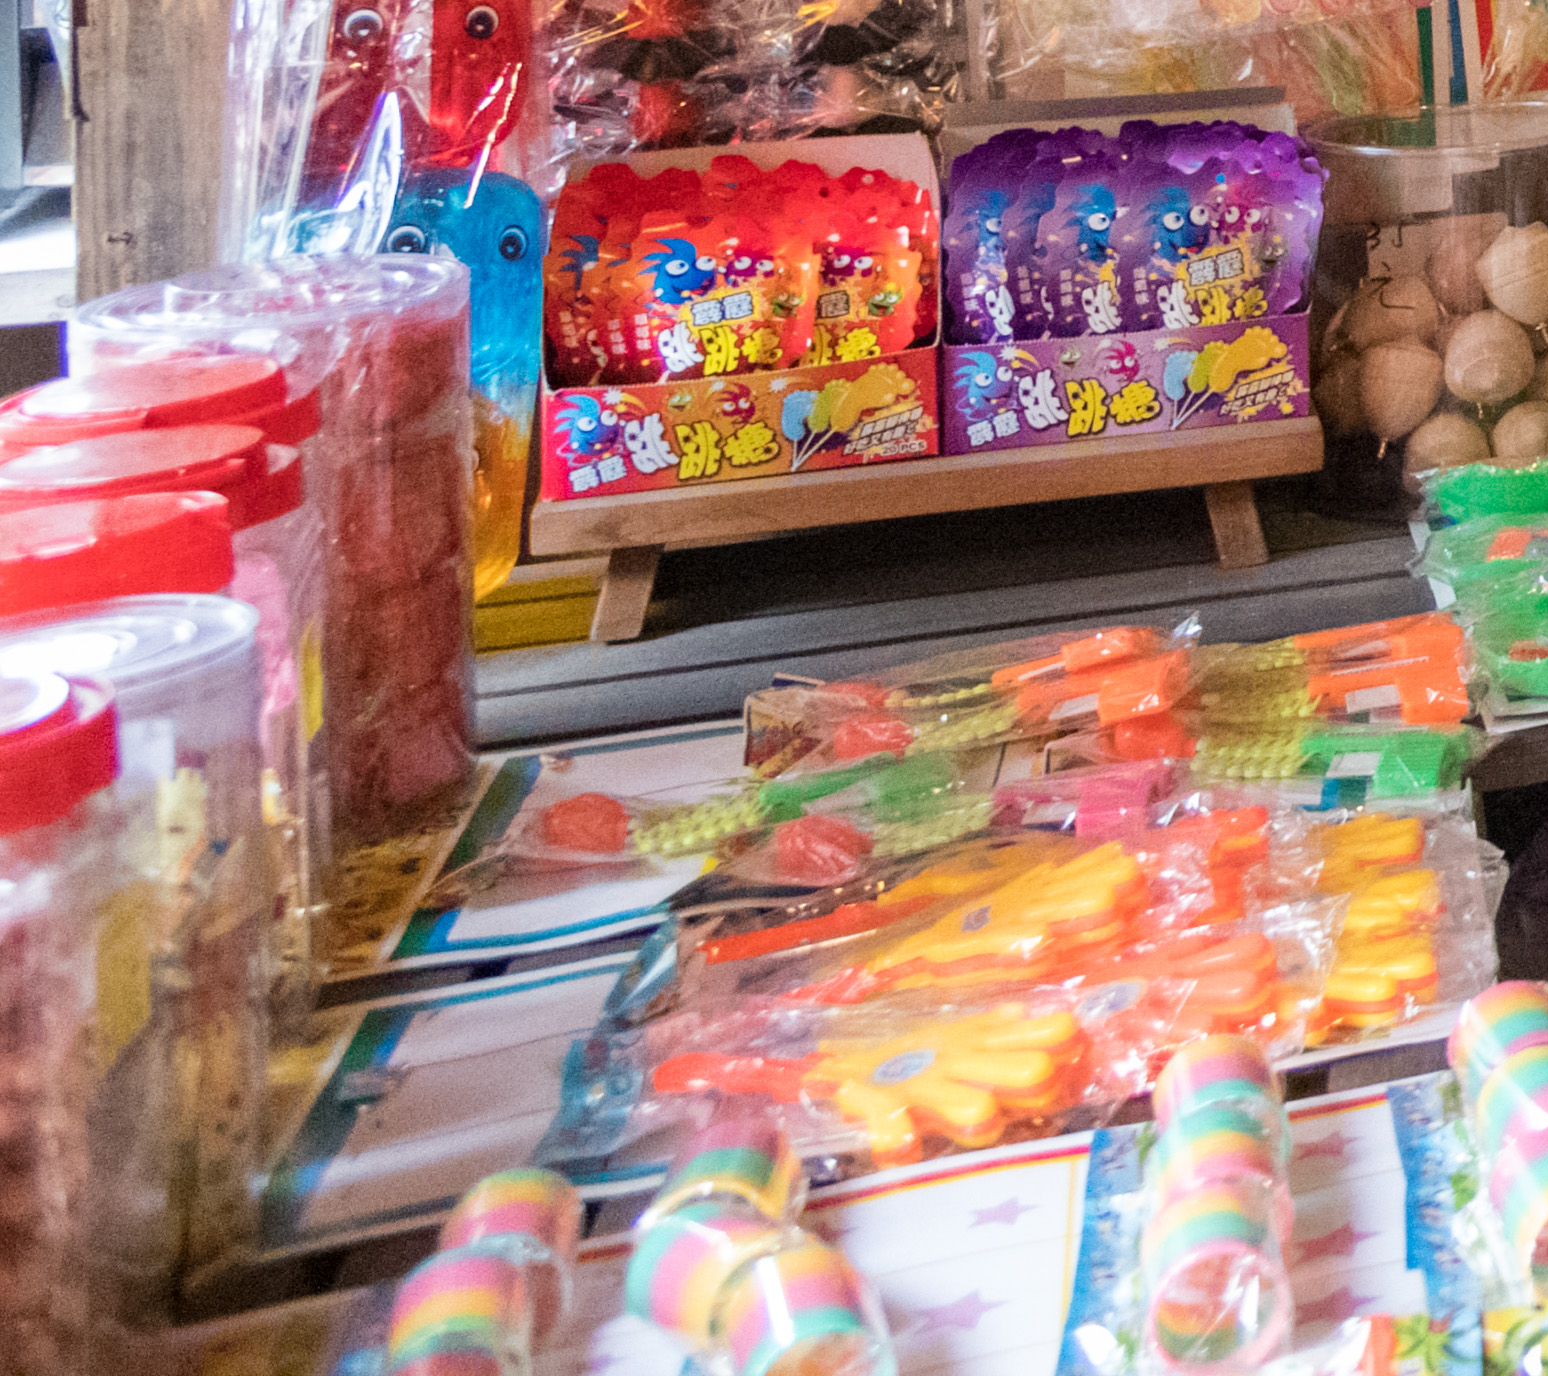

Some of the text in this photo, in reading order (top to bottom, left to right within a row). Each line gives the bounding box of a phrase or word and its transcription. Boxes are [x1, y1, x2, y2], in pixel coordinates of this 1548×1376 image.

[1016, 368, 1161, 438] 跳跳糖
[623, 412, 781, 482] 跳跳糖
